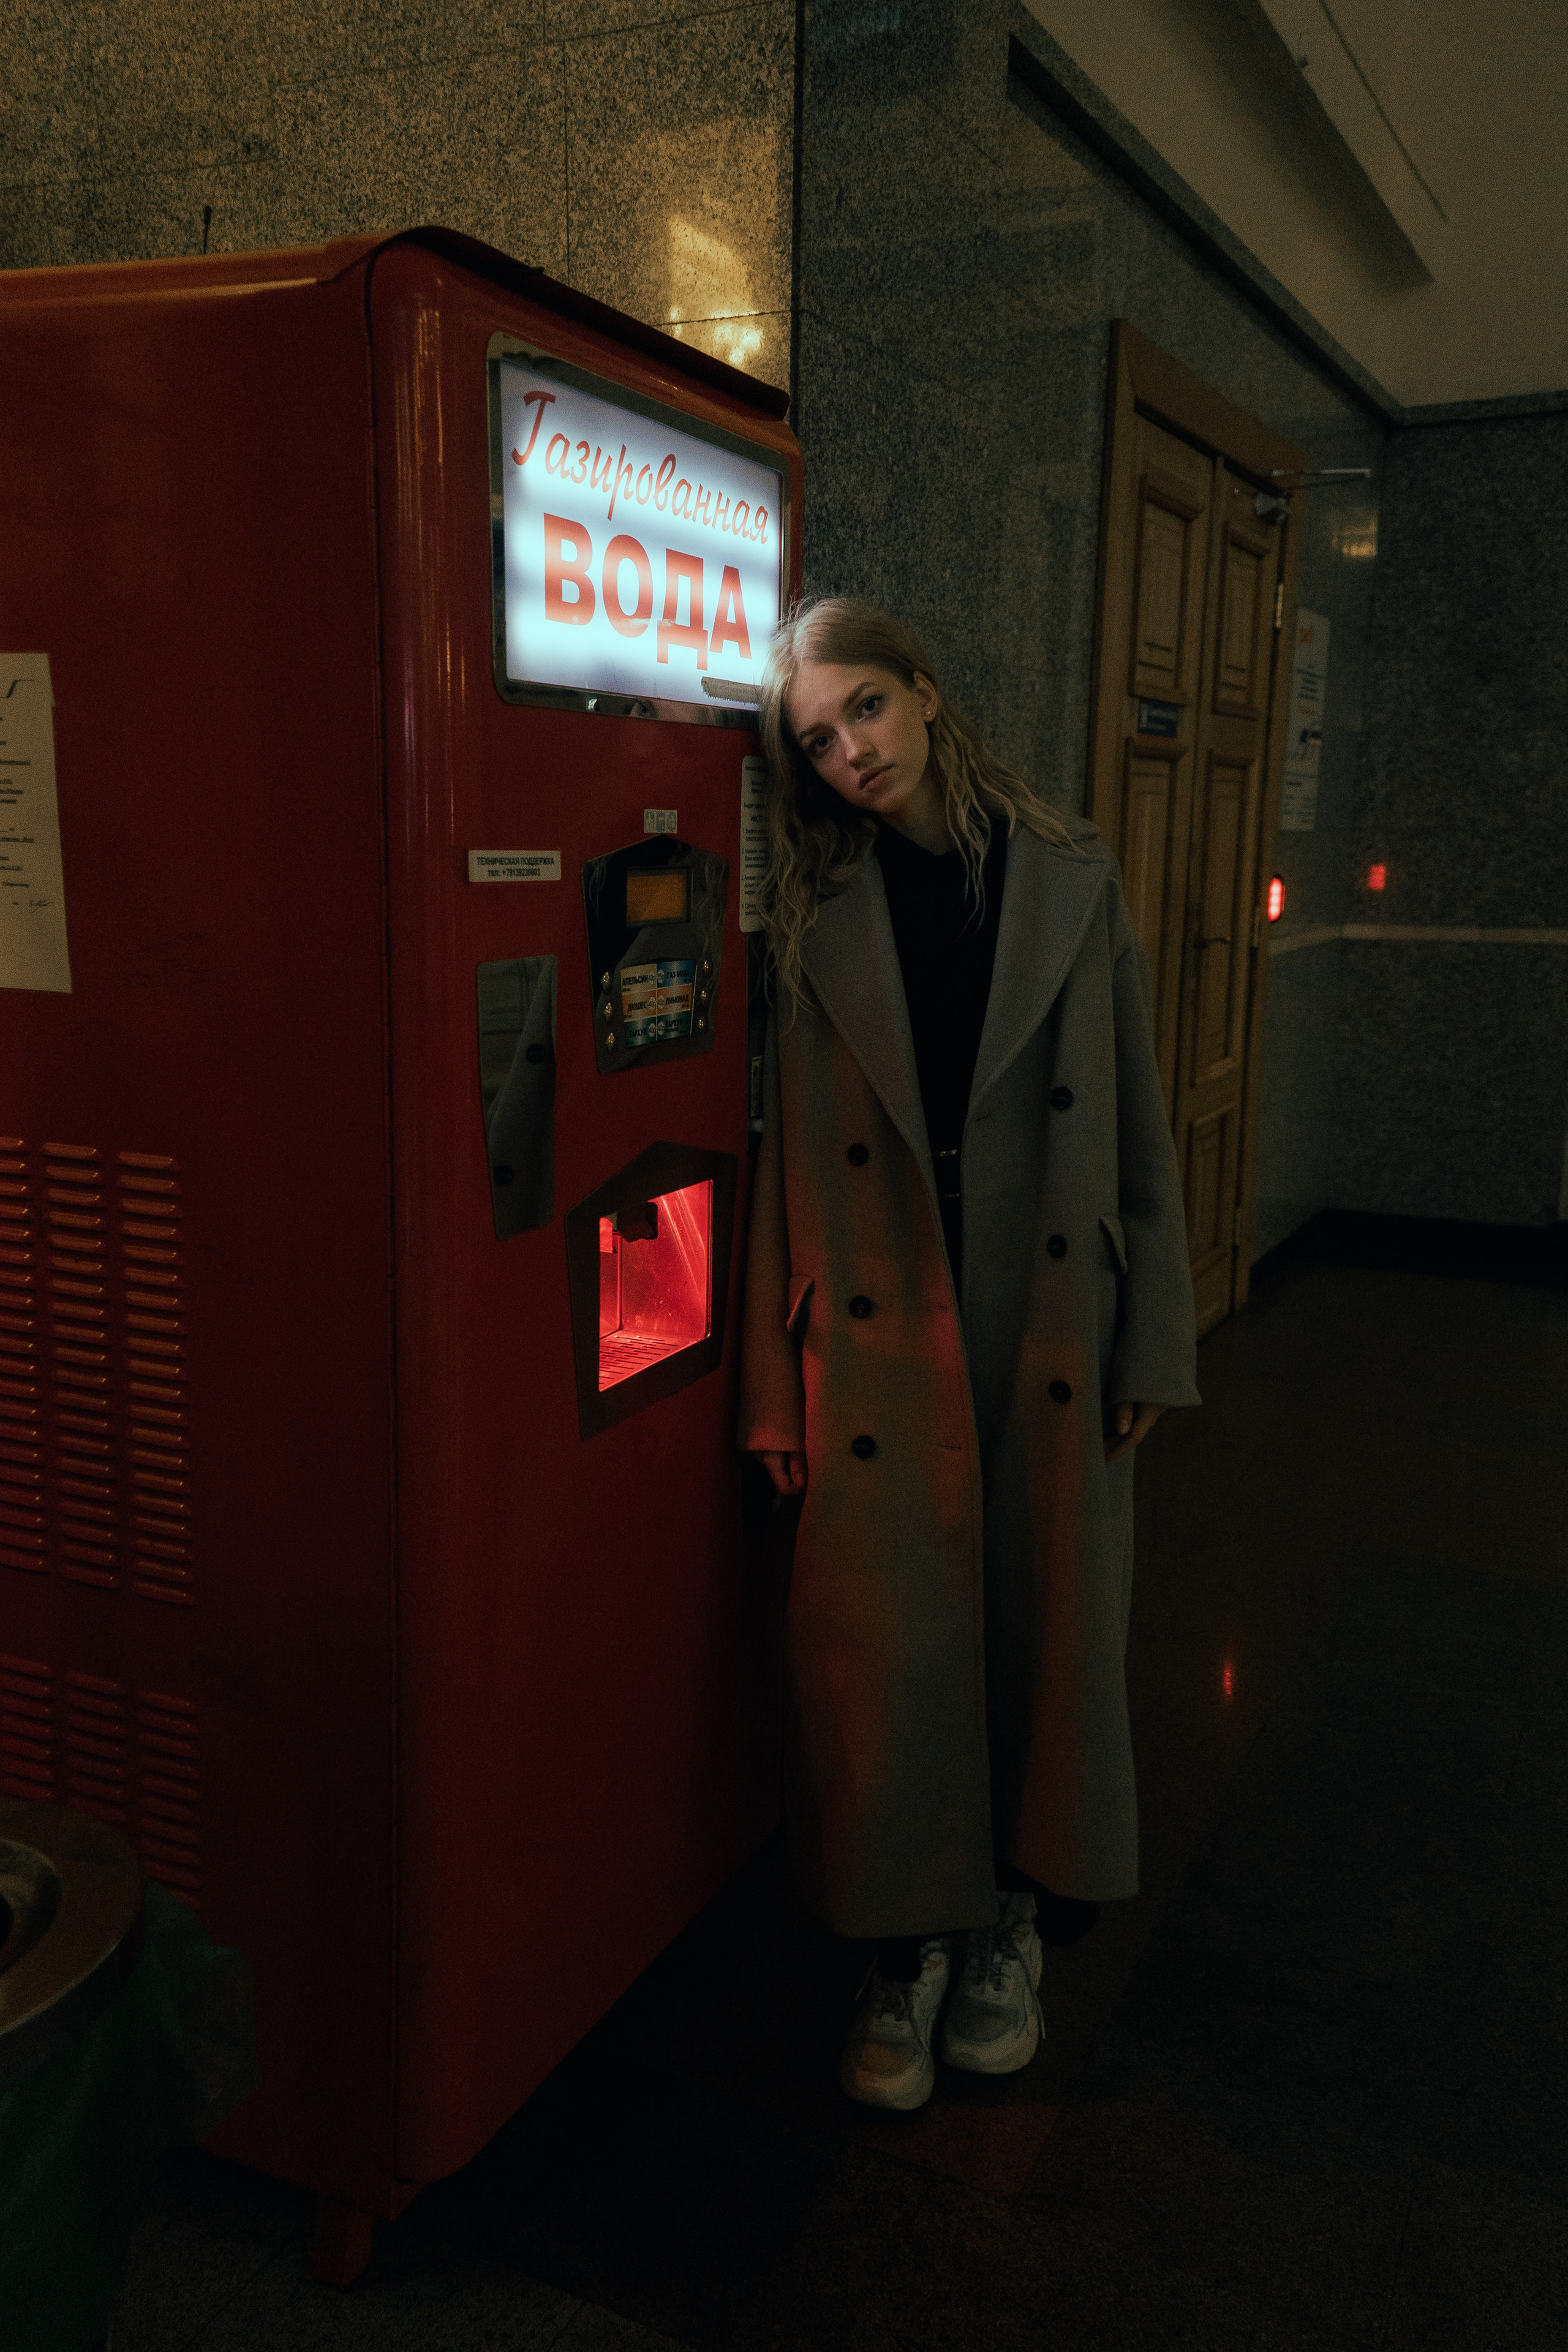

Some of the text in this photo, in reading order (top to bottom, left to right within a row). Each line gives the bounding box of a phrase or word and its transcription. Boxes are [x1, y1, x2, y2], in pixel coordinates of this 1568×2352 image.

[512, 391, 769, 544] Газированная
[544, 512, 752, 671] ВОДА
[622, 975, 648, 986] АПЕЛЬСИН
[666, 995, 689, 1005] ЛИМОНАД
[628, 1001, 647, 1012] ДЮШЕС
[666, 1019, 683, 1028] ТАРХУН
[629, 1028, 647, 1038] ТАРХУН
